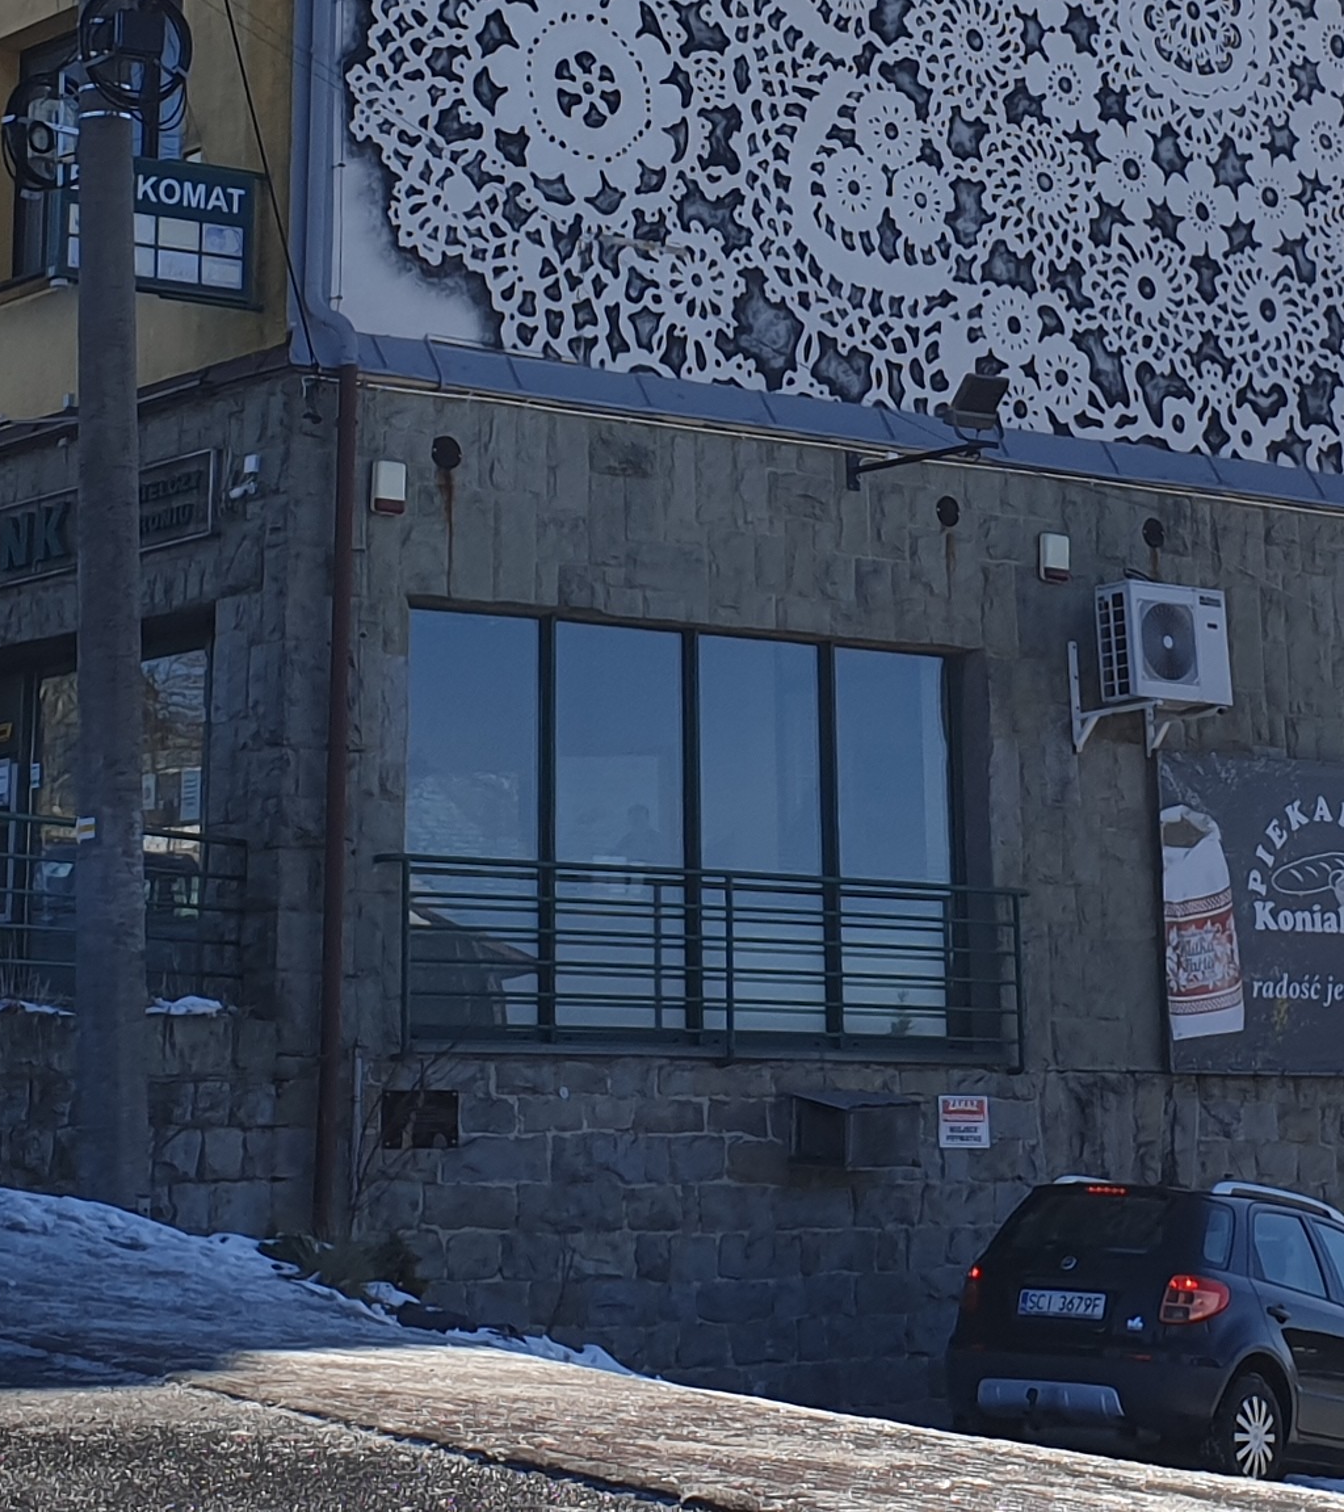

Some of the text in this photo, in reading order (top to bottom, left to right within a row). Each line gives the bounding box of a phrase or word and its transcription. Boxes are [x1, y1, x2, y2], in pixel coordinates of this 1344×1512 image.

[1253, 973, 1321, 1000] radość
[1028, 1293, 1103, 1314] SCI 3679F
